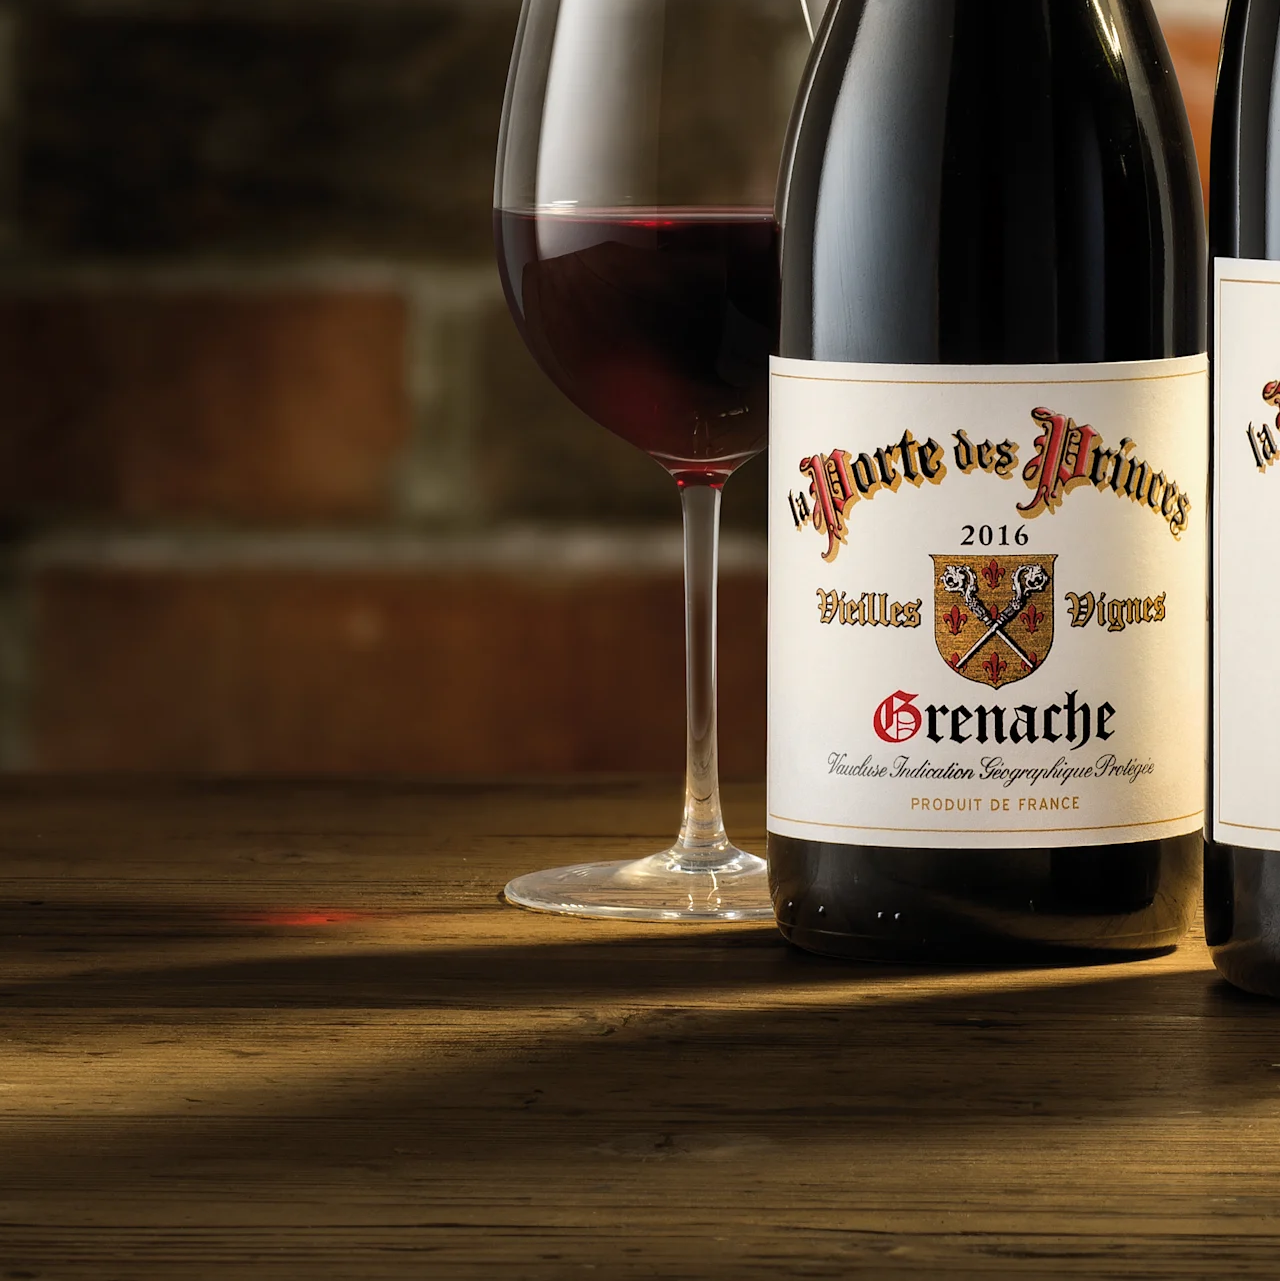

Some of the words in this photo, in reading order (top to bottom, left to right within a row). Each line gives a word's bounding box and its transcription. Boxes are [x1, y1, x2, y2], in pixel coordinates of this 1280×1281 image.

[798, 428, 948, 563] Porte
[952, 428, 1020, 479] des
[1015, 406, 1194, 541] Princes
[960, 524, 1031, 548] 2016
[815, 587, 923, 630] Vieilles
[1064, 590, 1169, 634] Vignes
[872, 688, 1118, 752] Grenache
[826, 751, 888, 777] Vaucluse
[888, 754, 976, 781] Indication
[978, 754, 1093, 789] Géographique
[1093, 752, 1156, 784] Protégée
[910, 796, 983, 812] PRODUIT
[990, 797, 1011, 812] DE
[1018, 796, 1081, 811] FRANCE
